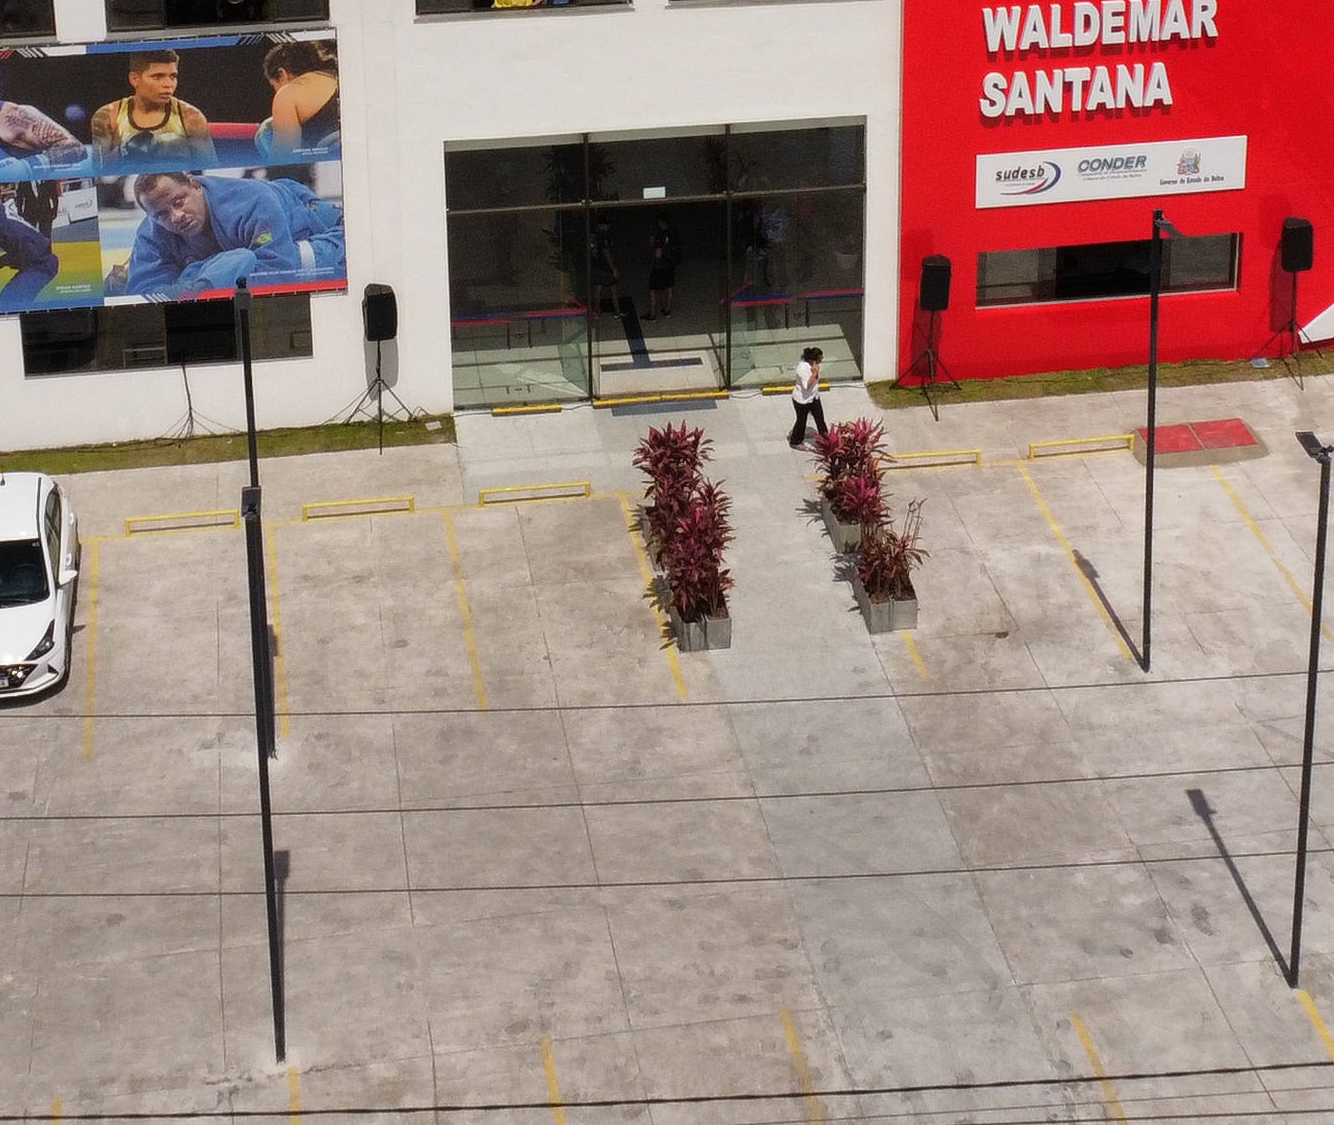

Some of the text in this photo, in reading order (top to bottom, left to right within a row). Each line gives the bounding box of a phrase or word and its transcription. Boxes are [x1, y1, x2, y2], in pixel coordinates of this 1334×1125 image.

[979, 62, 1174, 118] SANTANA
[1077, 155, 1147, 172] CONDER
[995, 165, 1045, 181] sudesb
